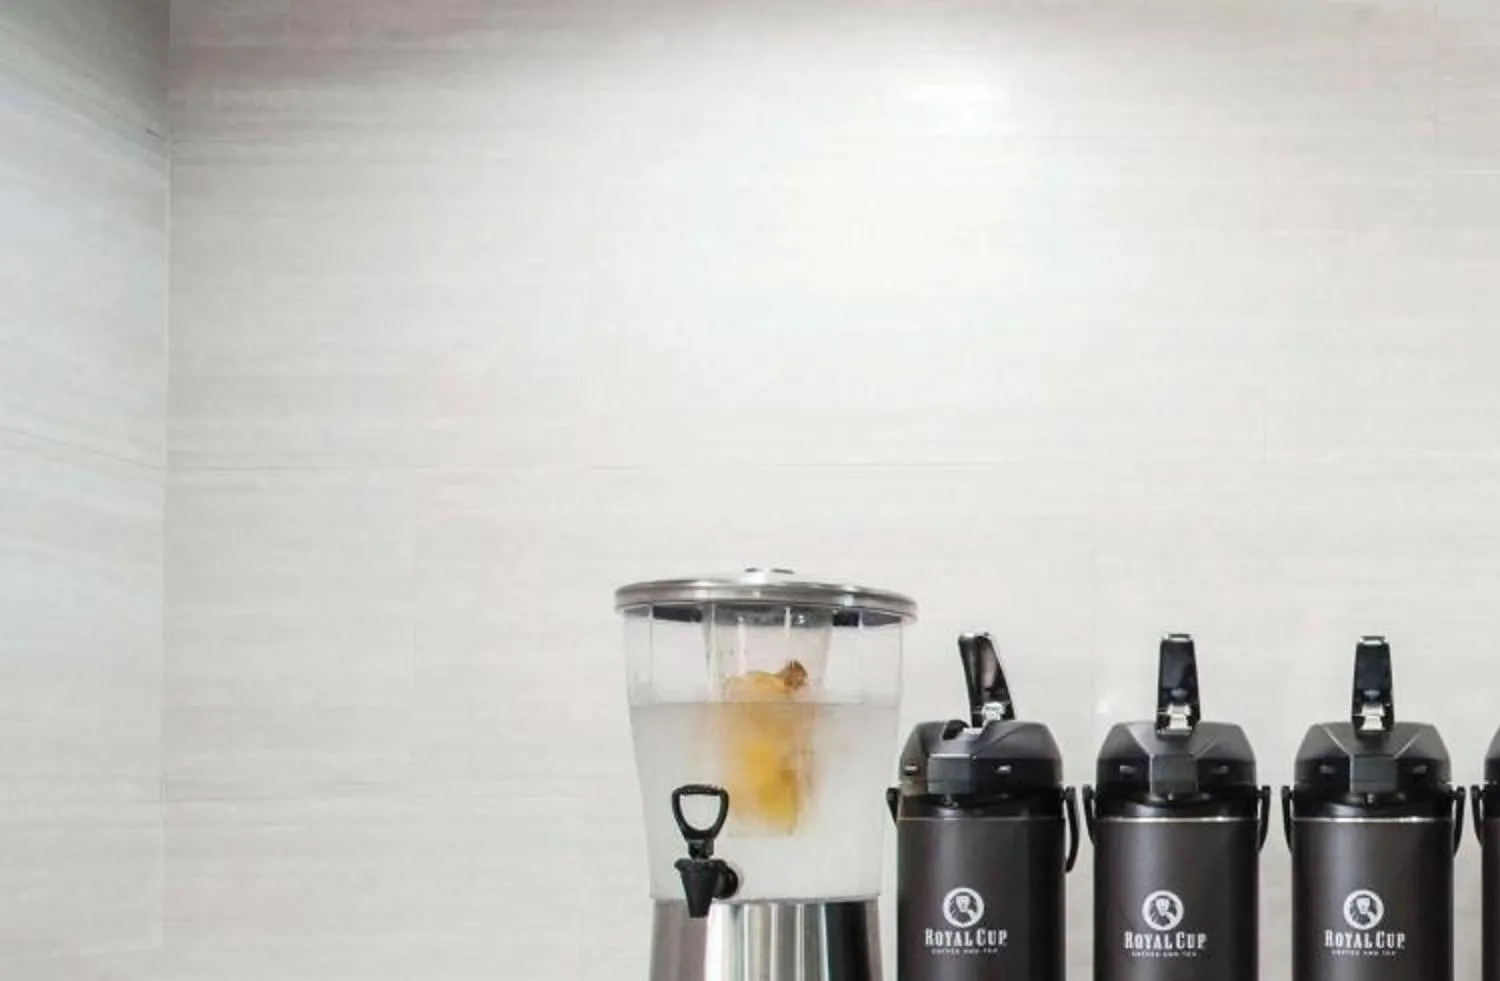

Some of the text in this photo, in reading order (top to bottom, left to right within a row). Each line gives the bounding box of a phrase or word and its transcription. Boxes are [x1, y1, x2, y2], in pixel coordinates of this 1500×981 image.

[925, 928, 1008, 947] ROYAL CUP
[1124, 931, 1207, 950] ROYAL CUP
[1325, 930, 1406, 949] ROYAL CUP
